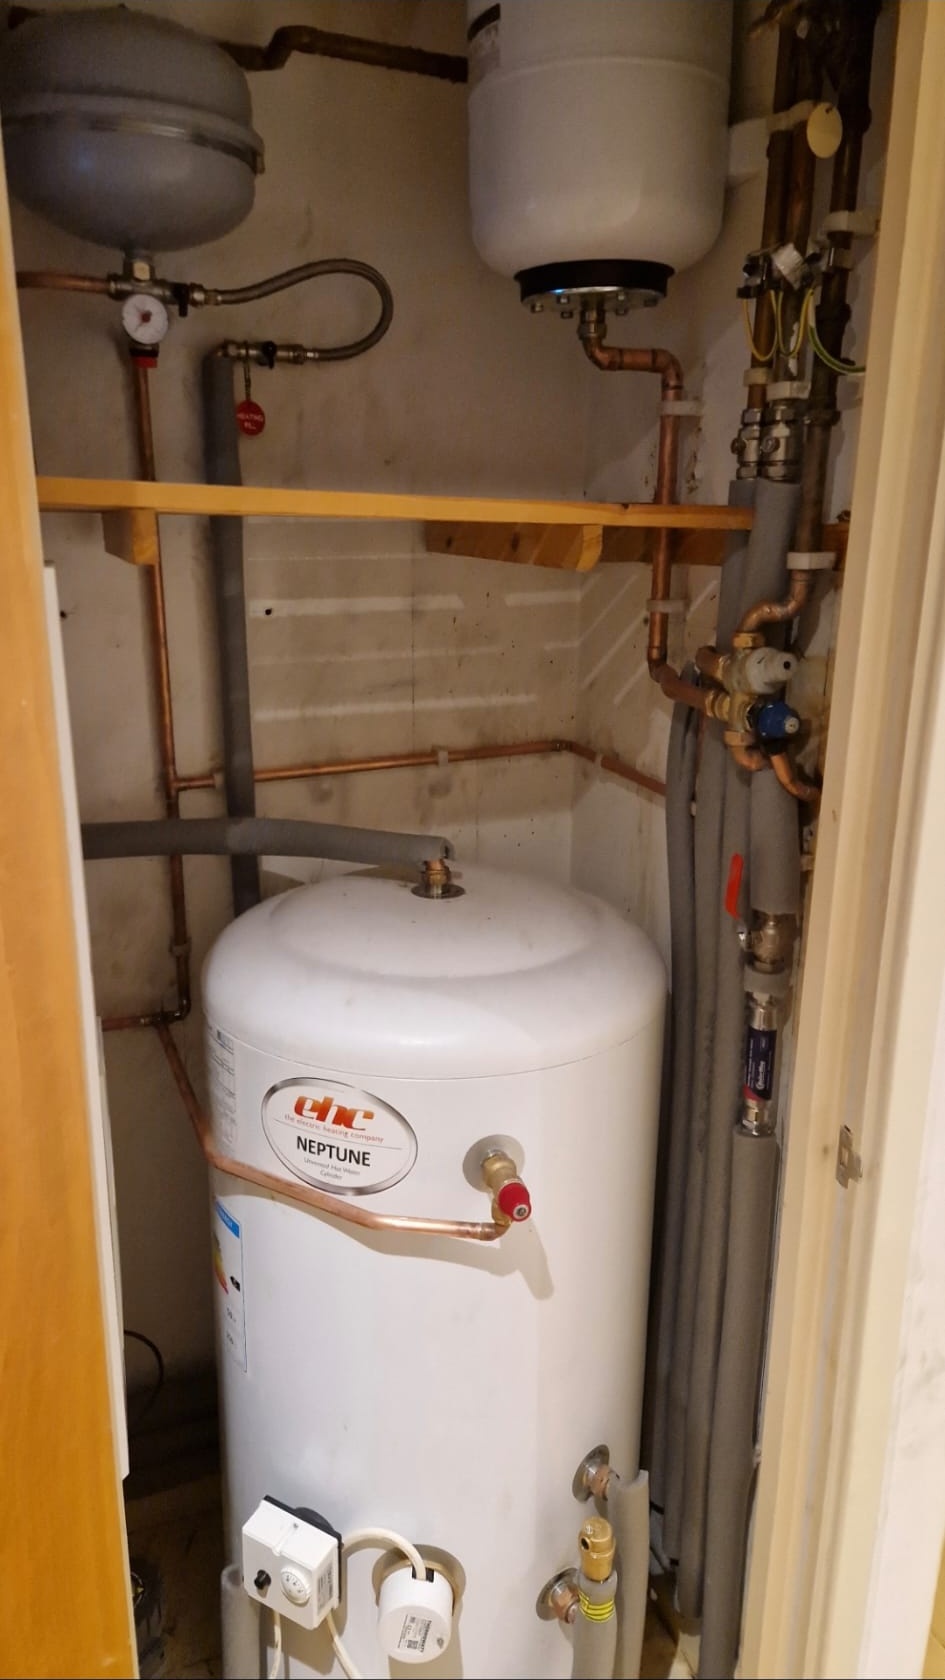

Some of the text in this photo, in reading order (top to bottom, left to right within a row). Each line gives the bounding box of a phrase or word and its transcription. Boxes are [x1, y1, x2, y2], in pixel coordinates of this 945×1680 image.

[284, 1113, 384, 1144] the electric heating company
[294, 1096, 374, 1131] ehc
[296, 1135, 371, 1167] NEPTUNE
[320, 1170, 343, 1180] Cylinder
[343, 1167, 361, 1175] Water
